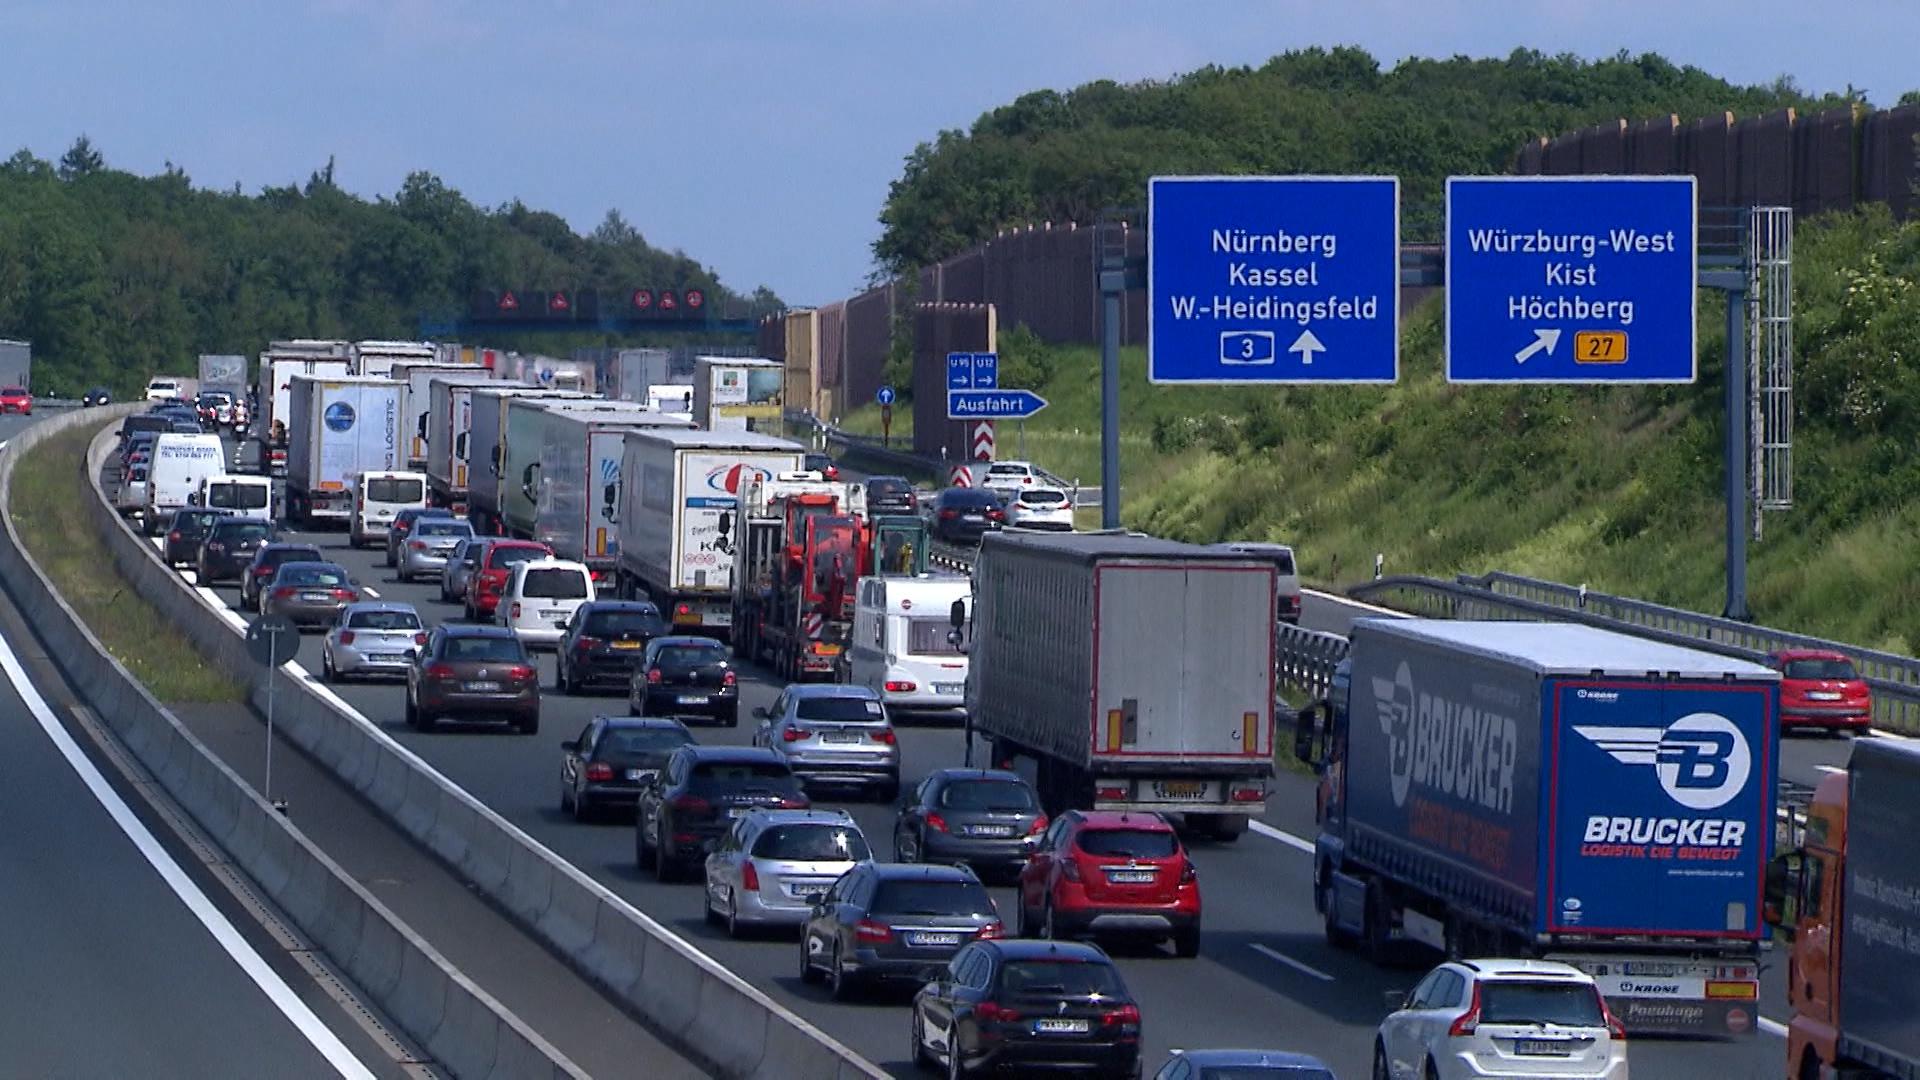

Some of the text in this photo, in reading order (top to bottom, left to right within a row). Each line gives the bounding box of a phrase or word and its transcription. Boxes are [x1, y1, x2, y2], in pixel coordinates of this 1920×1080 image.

[1212, 229, 1337, 258] Nürnberg
[1468, 229, 1675, 258] Würzburg-West
[1229, 262, 1319, 287] Kassel
[1546, 263, 1597, 287] Kist
[1171, 295, 1378, 325] W.-Heidingsfeld
[1508, 295, 1634, 325] Höchberg
[1240, 338, 1255, 358] 3
[1589, 337, 1614, 357] 27
[956, 397, 1024, 412] Ausfahrt
[1413, 692, 1517, 815] BRUCKER
[1584, 816, 1746, 847] BRUCKER
[1581, 843, 1646, 858] LOGISTIK
[1677, 847, 1740, 861] BEWEGT
[1634, 984, 1680, 995] KRONE
